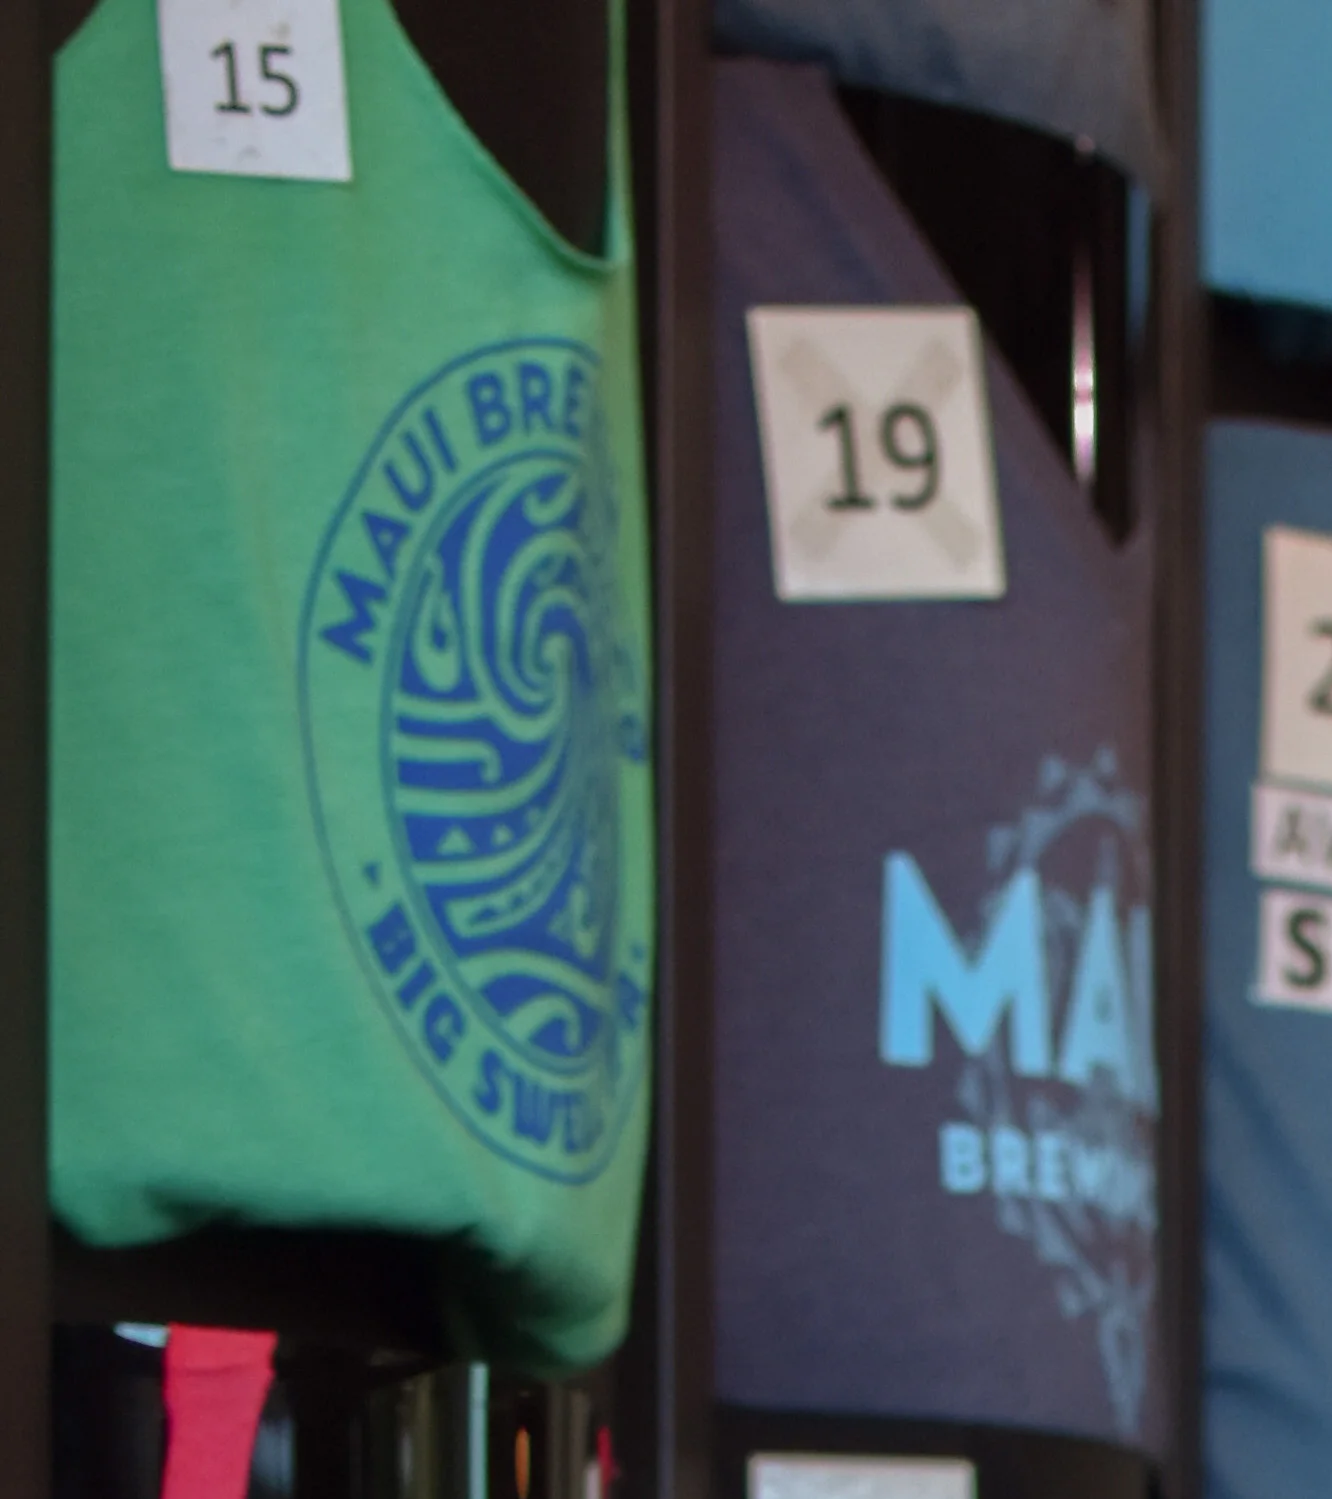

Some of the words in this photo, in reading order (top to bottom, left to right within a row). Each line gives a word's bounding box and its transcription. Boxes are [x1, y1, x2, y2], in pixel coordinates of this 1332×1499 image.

[211, 43, 301, 119] 15
[816, 403, 942, 512] 19
[318, 409, 458, 667] MAUI
[365, 902, 466, 1066] BIG
[1283, 907, 1328, 989] S
